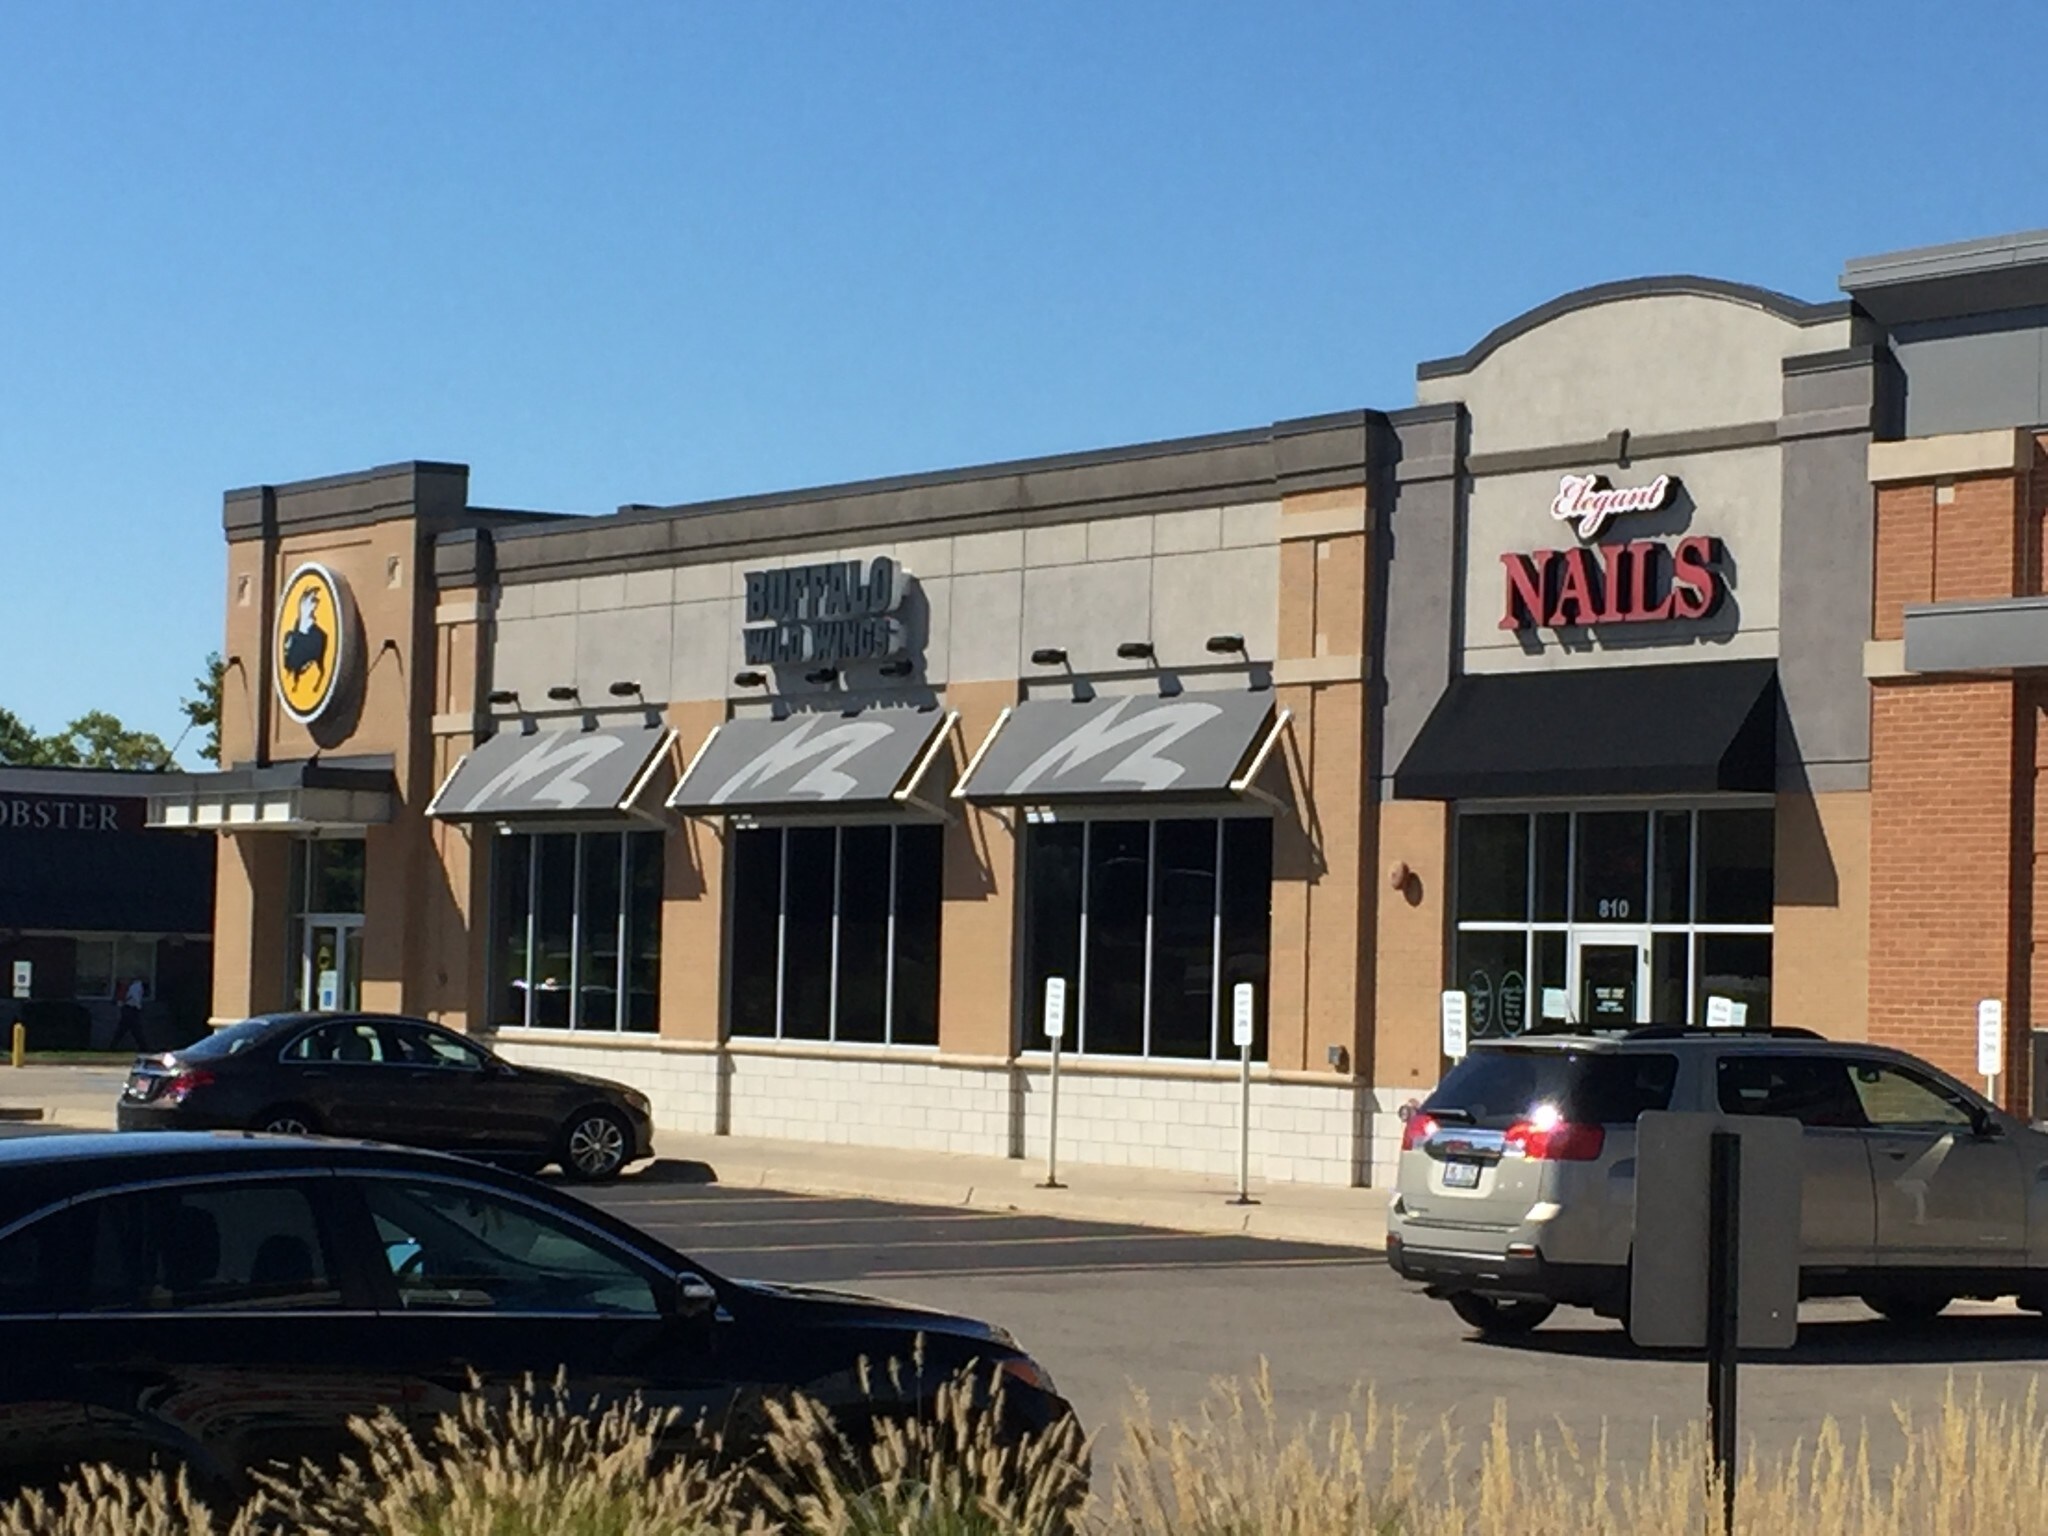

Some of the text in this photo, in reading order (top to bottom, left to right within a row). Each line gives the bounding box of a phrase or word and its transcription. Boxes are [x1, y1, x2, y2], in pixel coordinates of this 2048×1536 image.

[1551, 474, 1669, 538] Elegant
[744, 556, 893, 624] BUFFALO
[1498, 536, 1713, 630] NAILS
[743, 617, 892, 665] WILD WINGS
[1599, 899, 1629, 918] 810
